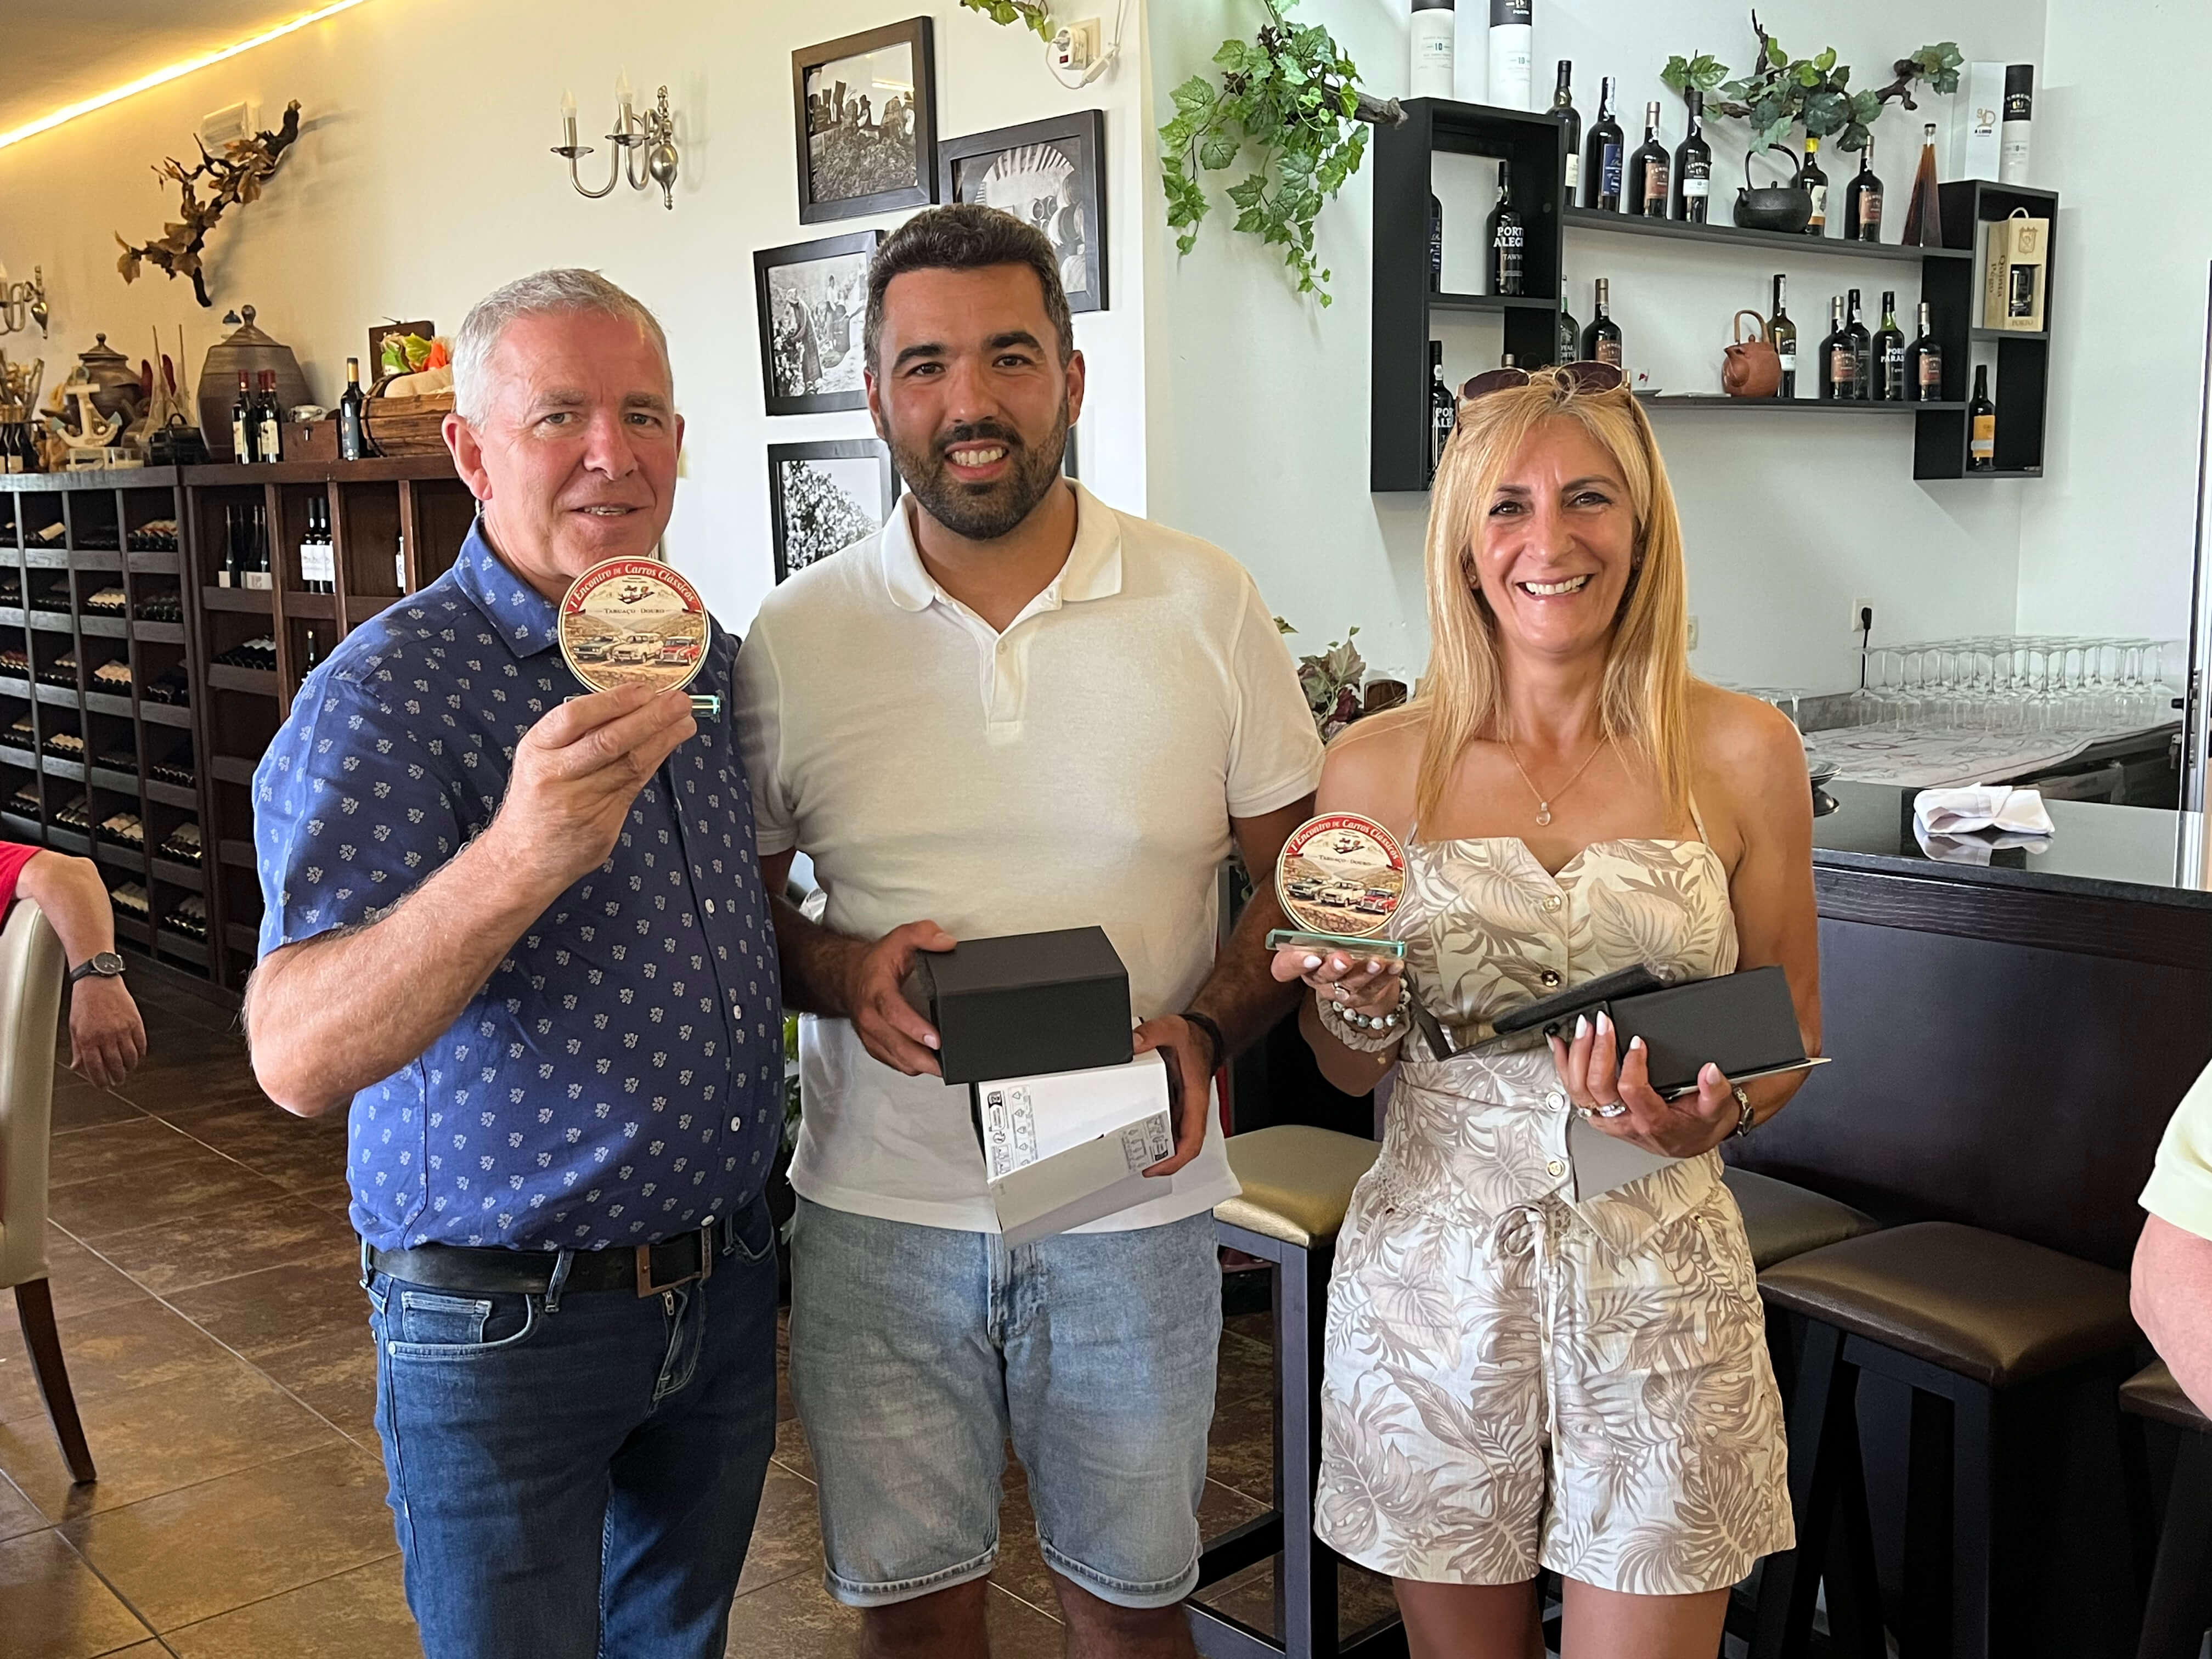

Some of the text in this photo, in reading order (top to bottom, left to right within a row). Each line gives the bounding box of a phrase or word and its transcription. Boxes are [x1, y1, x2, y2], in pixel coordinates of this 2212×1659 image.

[1435, 42, 1443, 51] 10
[1518, 57, 1526, 65] 10
[1497, 227, 1523, 237] PORT
[574, 569, 611, 598] Encontro
[625, 564, 656, 576] Carros
[1296, 821, 1331, 843] Encontro
[1342, 819, 1369, 833] Carros
